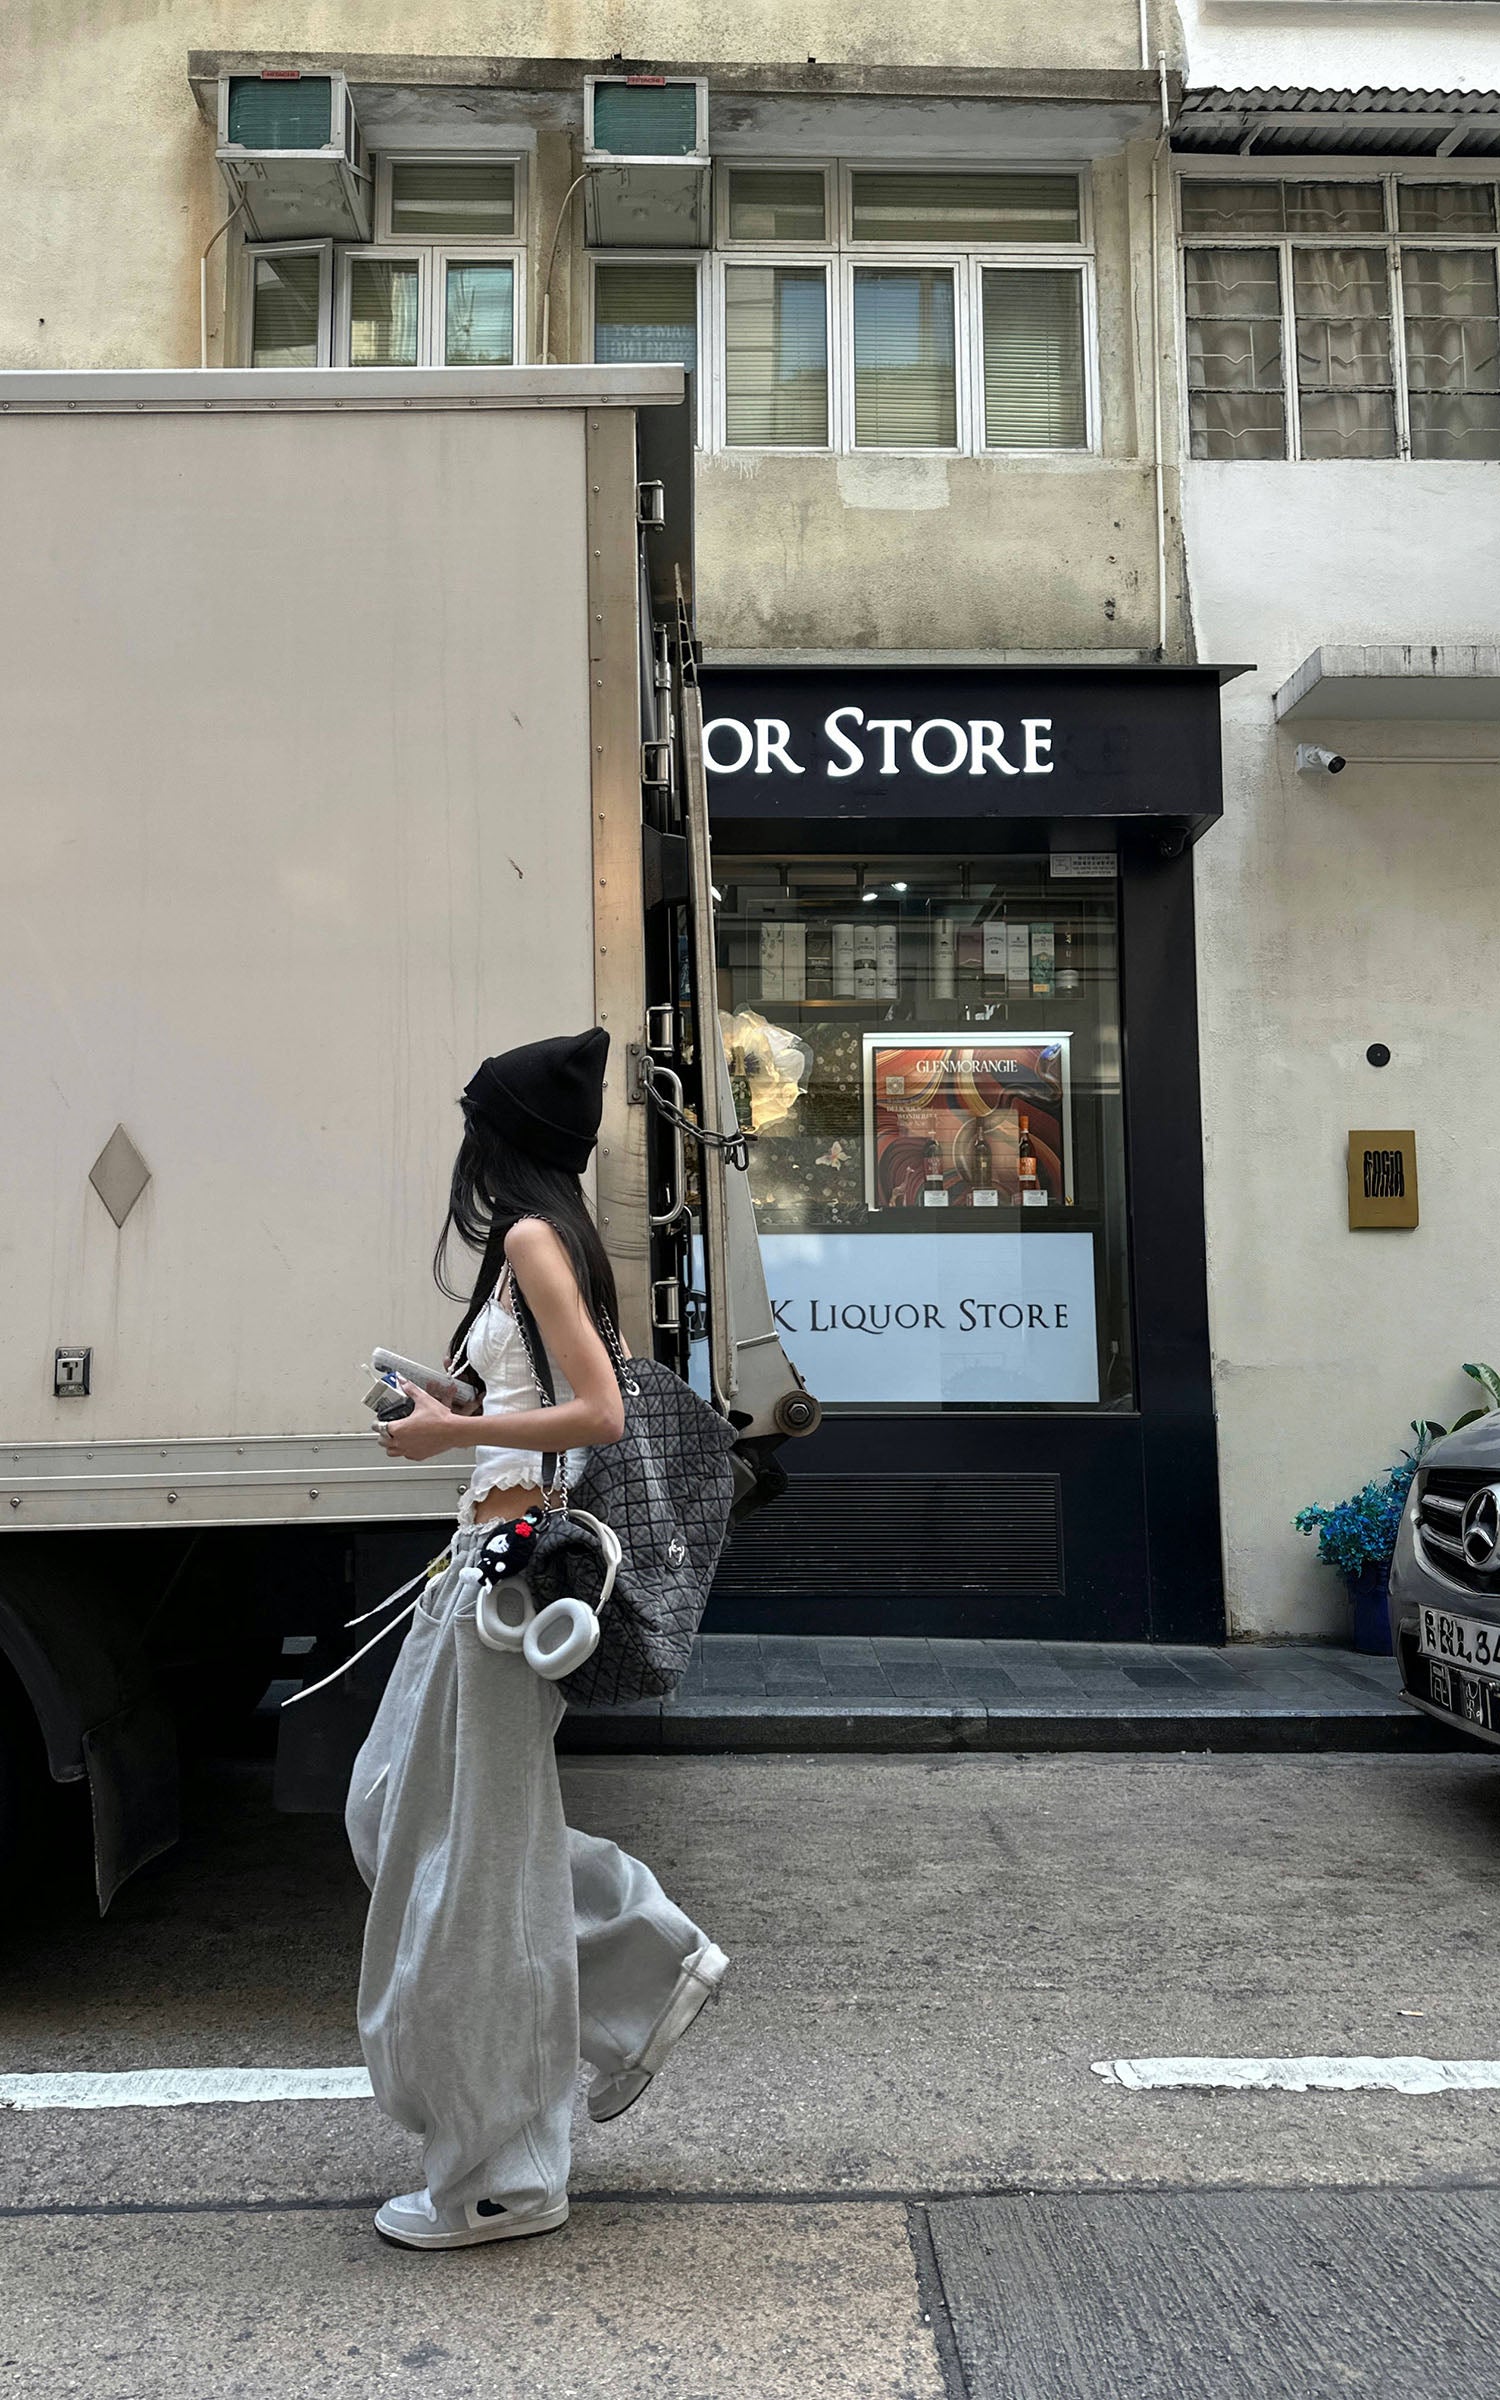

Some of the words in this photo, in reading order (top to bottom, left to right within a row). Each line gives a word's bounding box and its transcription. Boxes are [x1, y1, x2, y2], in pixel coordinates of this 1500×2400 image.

[825, 706, 1054, 778] STORE
[916, 1060, 1018, 1073] GLENMORANGIE
[810, 1300, 946, 1335] LIQUOR
[959, 1299, 1069, 1332] STORE
